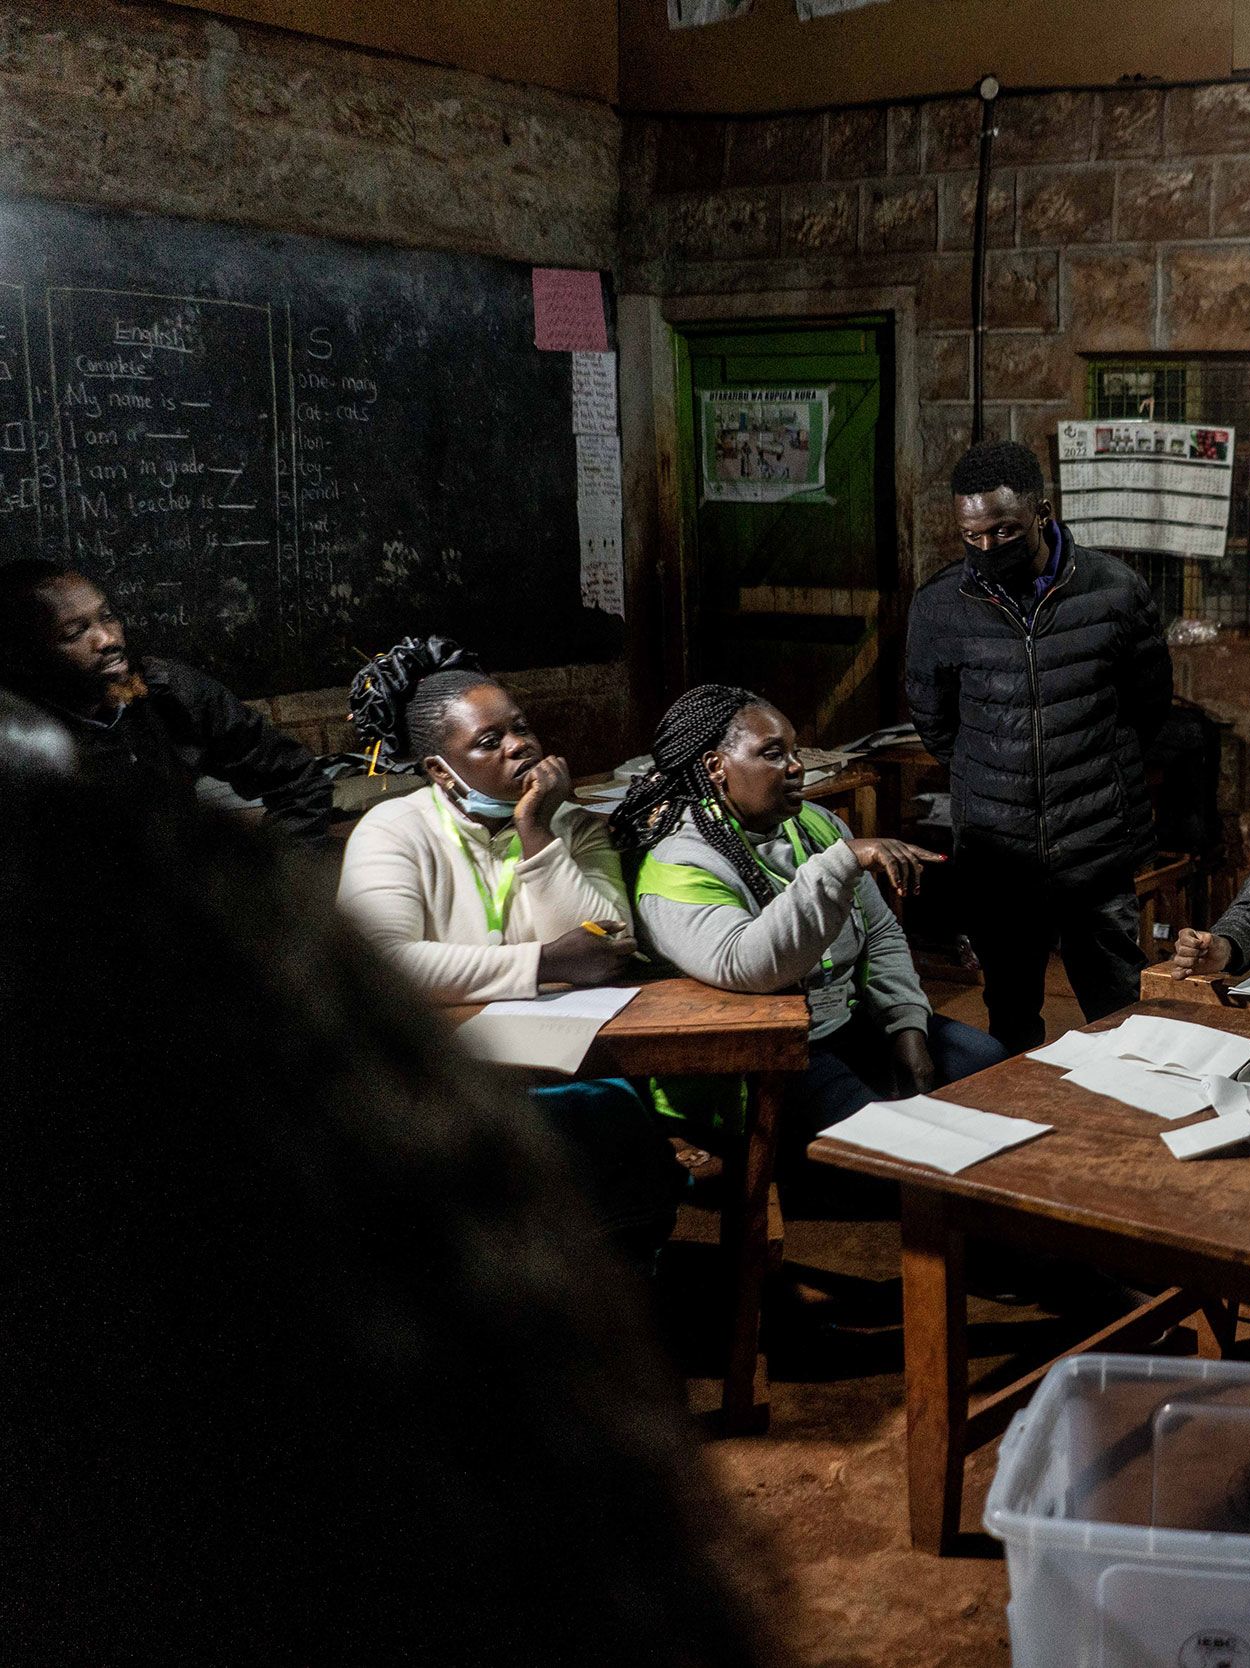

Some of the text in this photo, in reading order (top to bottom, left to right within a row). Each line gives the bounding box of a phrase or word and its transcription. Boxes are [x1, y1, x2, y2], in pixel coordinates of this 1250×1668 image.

[115, 321, 187, 359] English
[307, 326, 333, 360] S
[76, 354, 147, 381] Complete
[109, 392, 154, 409] name
[1064, 448, 1088, 459] 2022
